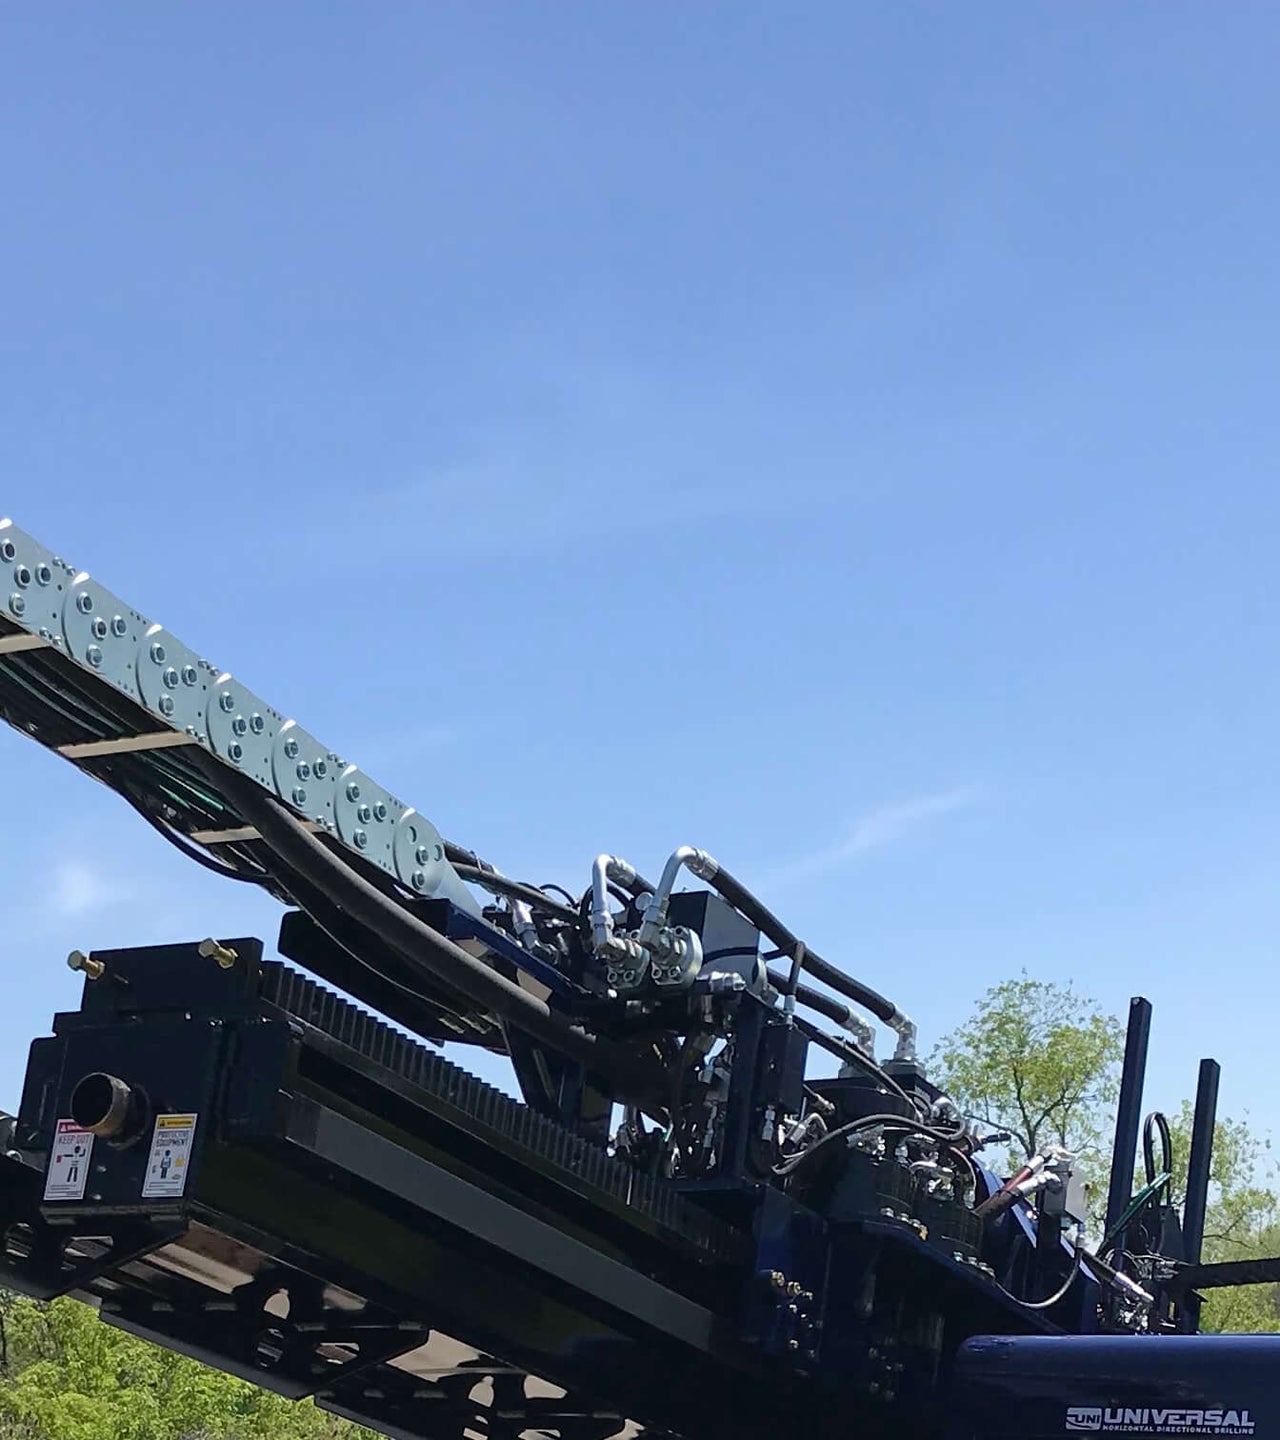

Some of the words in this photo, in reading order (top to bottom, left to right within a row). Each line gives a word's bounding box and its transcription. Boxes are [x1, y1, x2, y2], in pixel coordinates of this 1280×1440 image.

[1104, 1408, 1255, 1426] UNIVERSAL
[1102, 1424, 1154, 1432] HORIZONTAL
[1156, 1426, 1212, 1434] DIRECTIONAL
